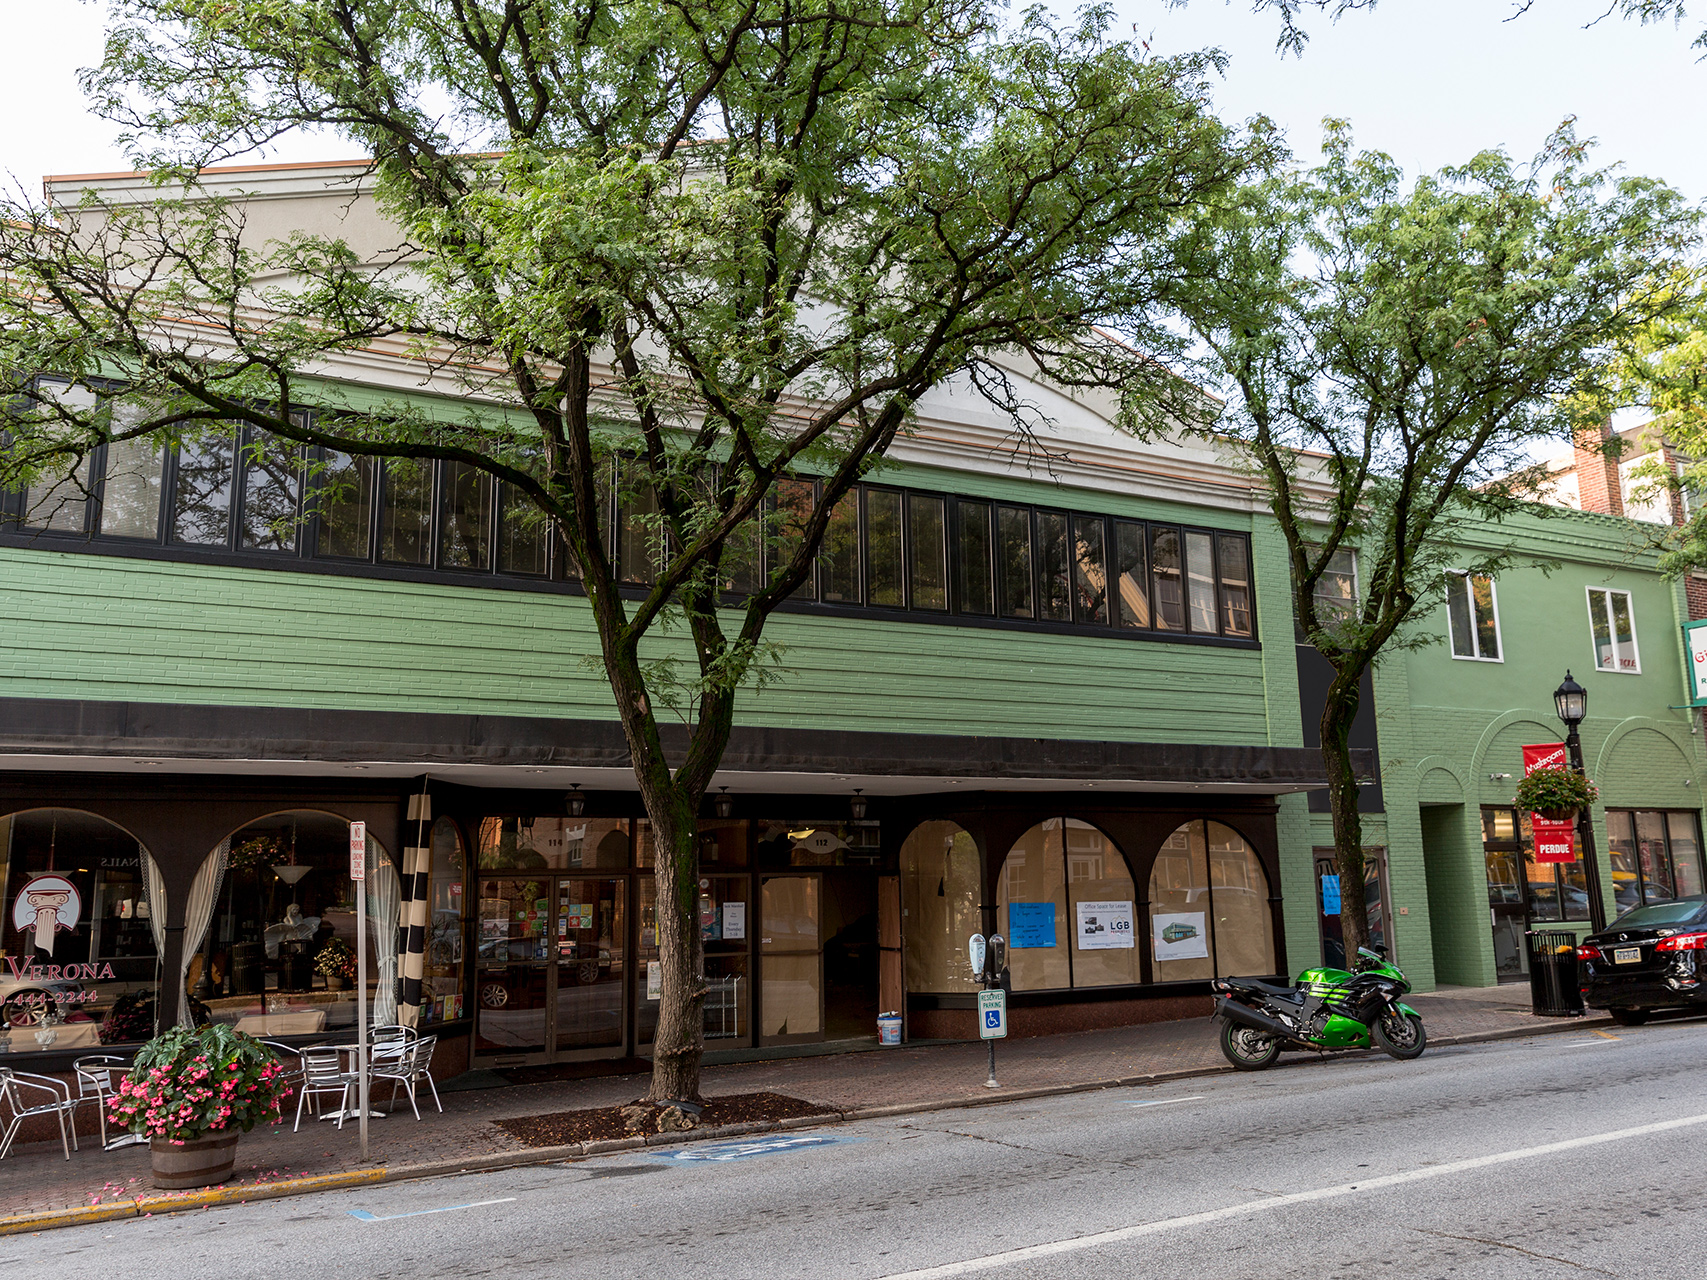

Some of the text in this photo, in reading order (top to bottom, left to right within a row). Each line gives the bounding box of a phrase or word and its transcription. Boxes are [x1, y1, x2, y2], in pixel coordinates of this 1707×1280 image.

[1526, 749, 1564, 774] Mushroom
[354, 827, 361, 838] NO
[351, 840, 364, 850] PARKING
[815, 839, 828, 847] 112
[1540, 844, 1570, 854] PERDUE
[1110, 921, 1130, 930] LGB
[981, 993, 1003, 1001] RESERVED
[983, 1001, 1002, 1009] PARKING
